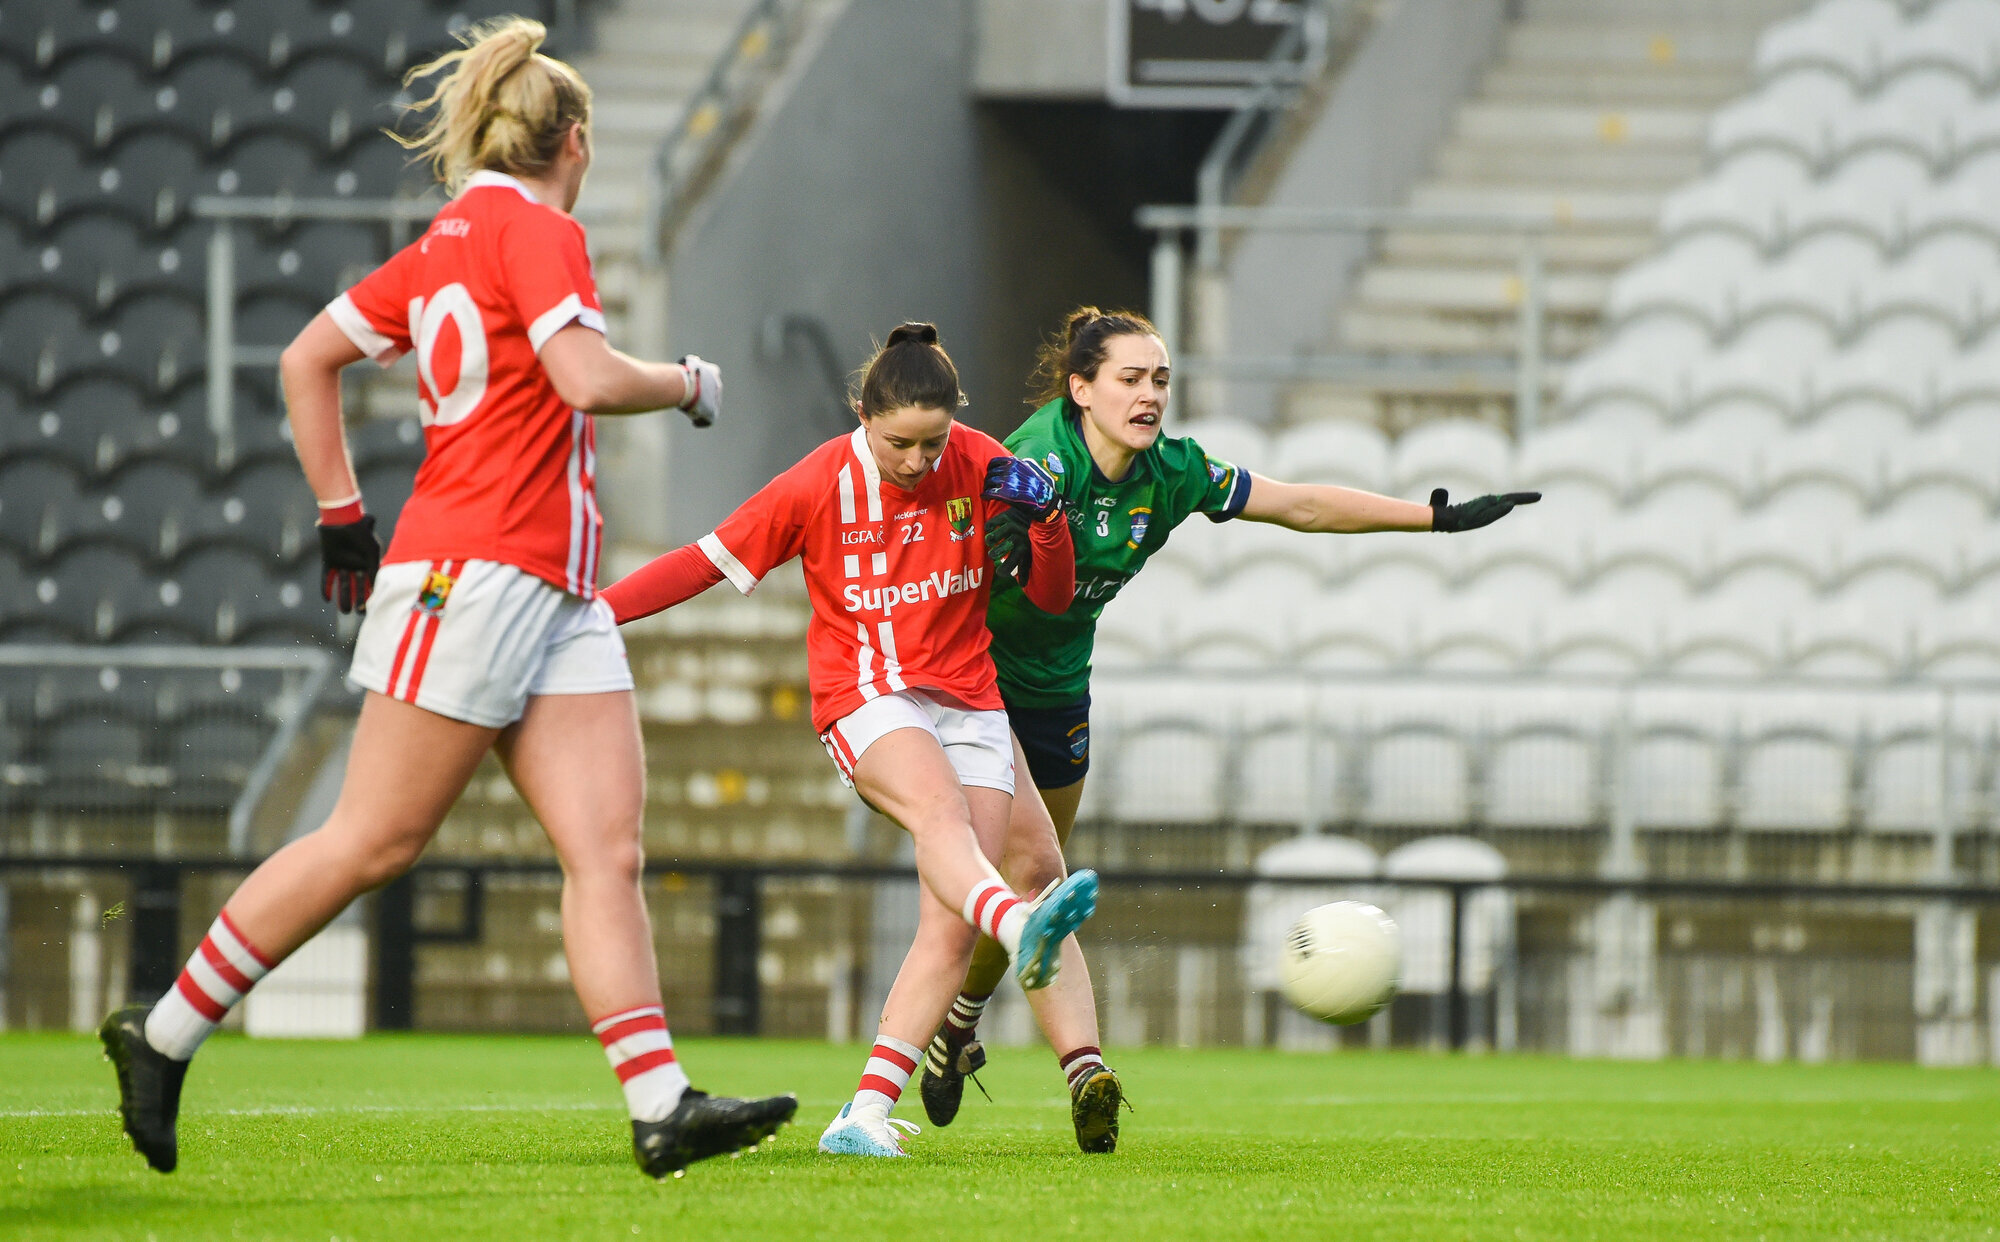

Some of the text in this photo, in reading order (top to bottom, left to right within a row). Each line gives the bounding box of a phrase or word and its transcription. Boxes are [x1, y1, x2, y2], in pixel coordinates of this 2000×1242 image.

[893, 508, 929, 521] McKeever
[1096, 510, 1110, 537] 3
[841, 530, 877, 545] LGFA
[900, 522, 925, 545] 22
[844, 564, 983, 617] SuperValu
